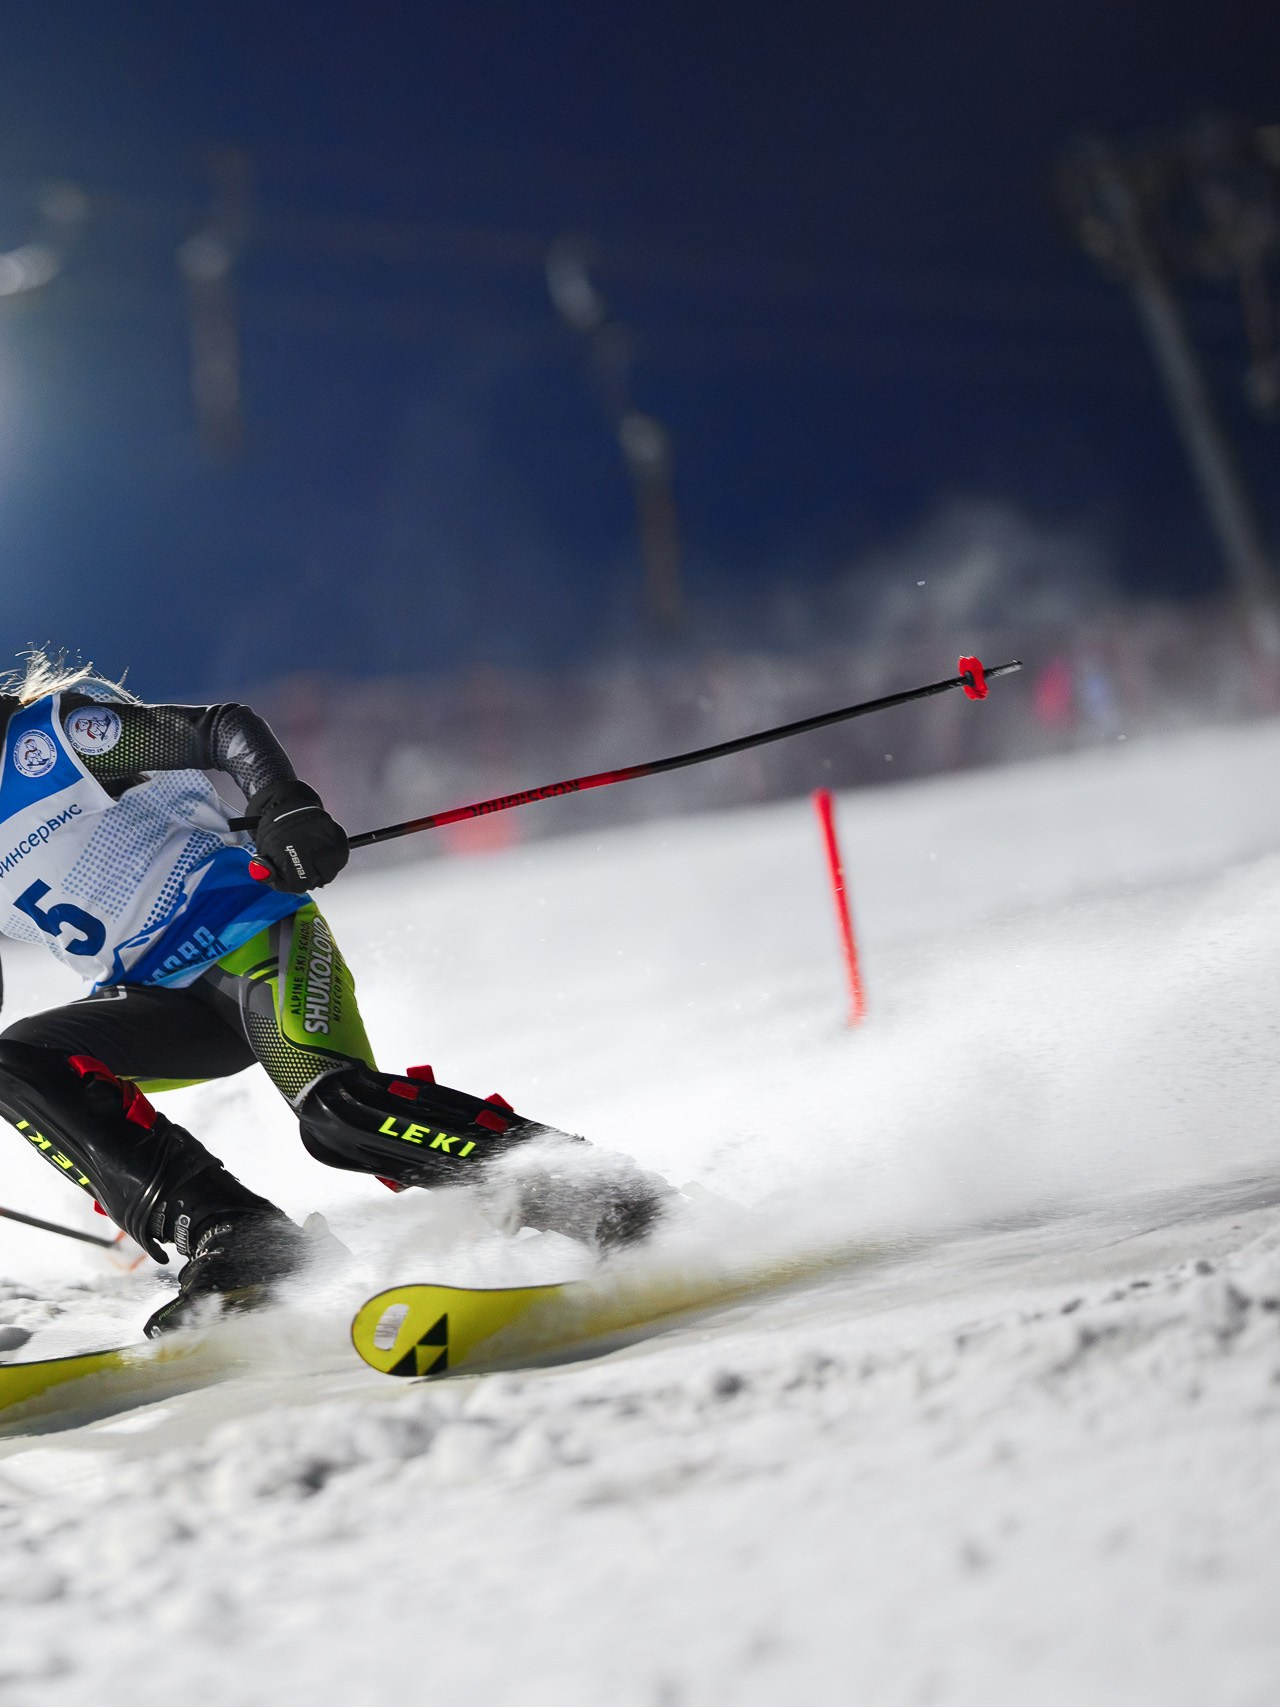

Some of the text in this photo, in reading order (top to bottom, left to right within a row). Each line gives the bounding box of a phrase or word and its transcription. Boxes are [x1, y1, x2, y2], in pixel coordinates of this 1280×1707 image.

[285, 844, 307, 881] reusch
[12, 878, 107, 957] 5
[294, 955, 306, 973] SKI
[290, 976, 304, 1016] ALPINE
[15, 1119, 91, 1186] LEKI
[378, 1116, 477, 1158] LEKI
